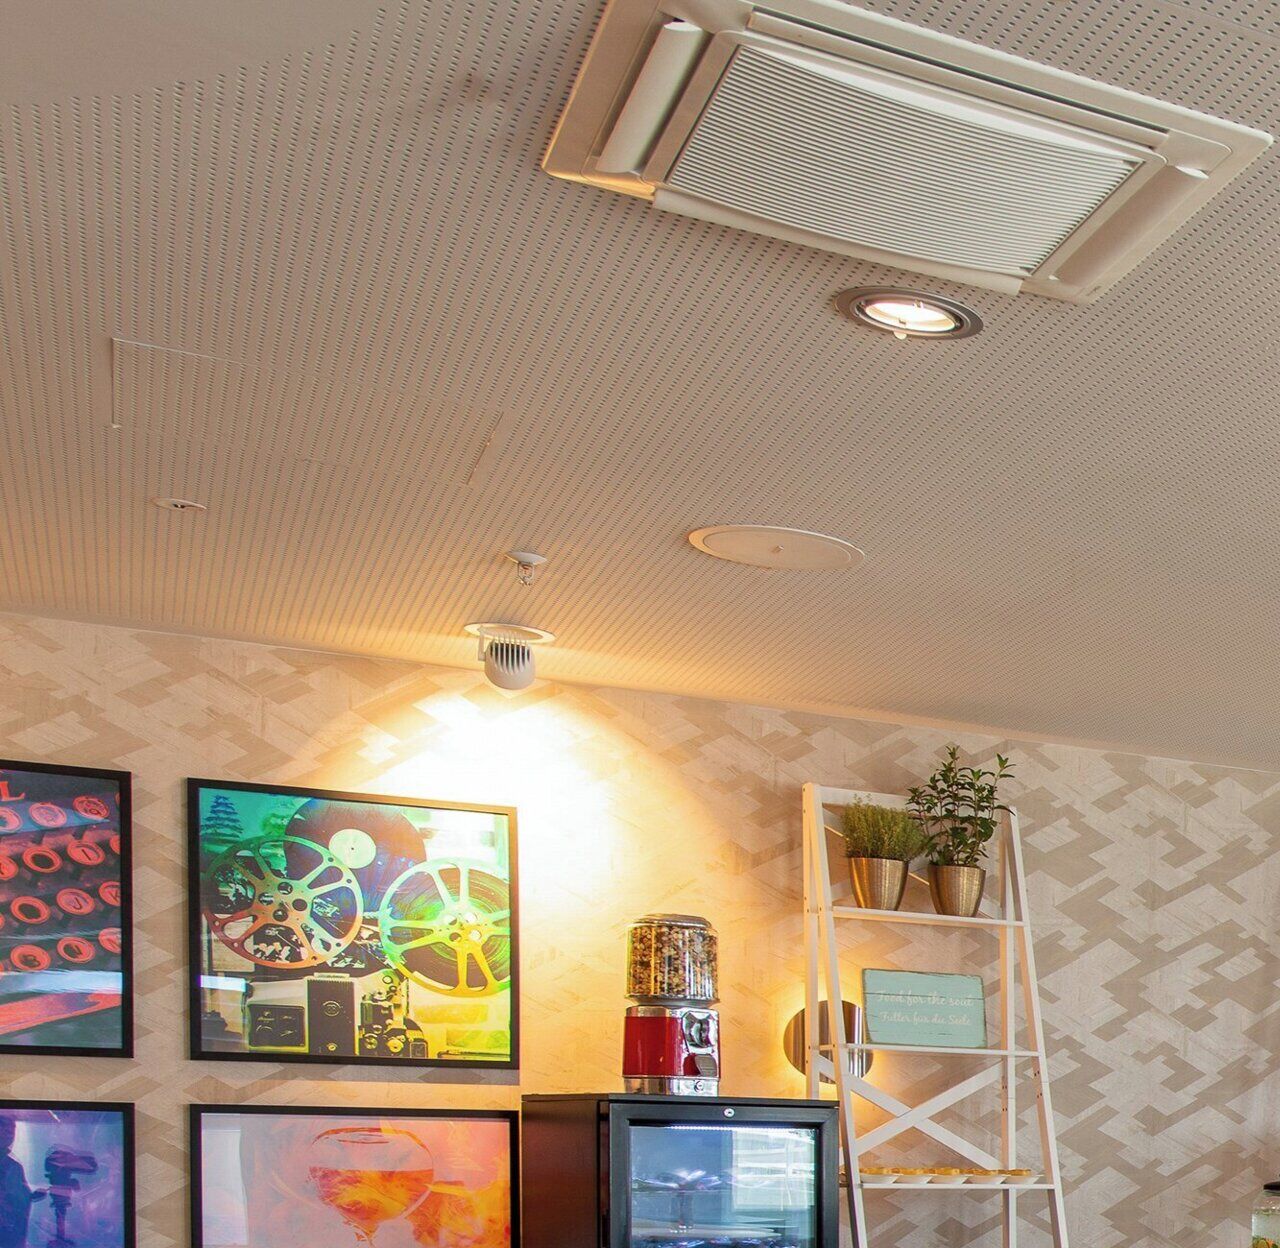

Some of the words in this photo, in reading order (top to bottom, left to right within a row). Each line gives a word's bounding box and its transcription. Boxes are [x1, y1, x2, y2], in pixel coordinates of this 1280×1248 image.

[906, 989, 926, 1007] for
[927, 991, 947, 1006] the
[948, 994, 974, 1007] soul
[880, 1010, 911, 1023] Futter
[931, 1012, 947, 1024] die
